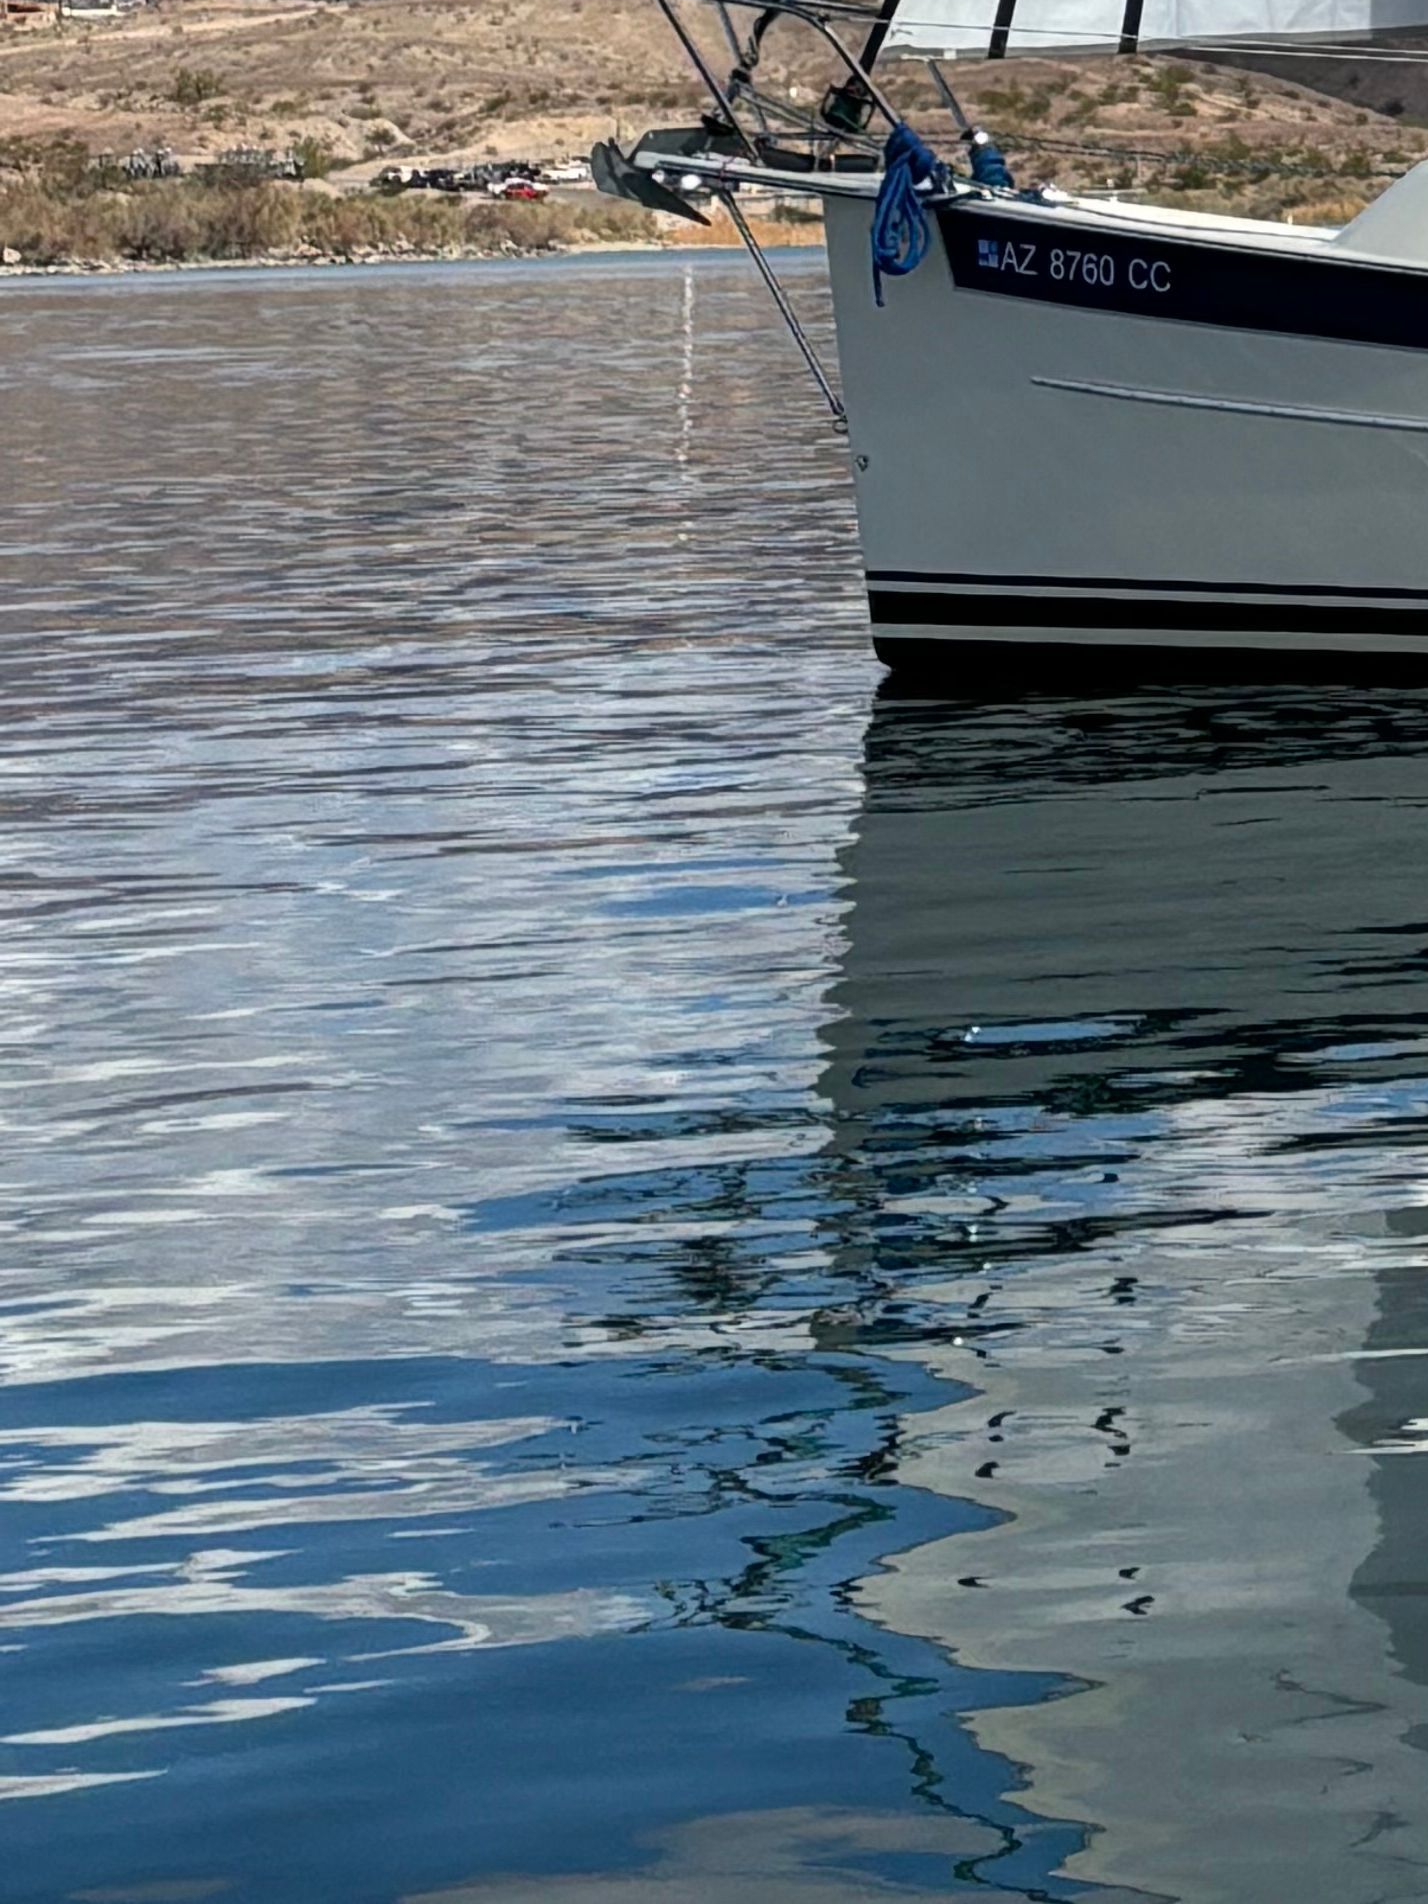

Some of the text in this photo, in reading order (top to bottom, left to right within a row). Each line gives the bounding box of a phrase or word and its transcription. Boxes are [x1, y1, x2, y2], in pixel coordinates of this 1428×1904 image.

[1001, 242, 1171, 292] AZ 8760 CC
